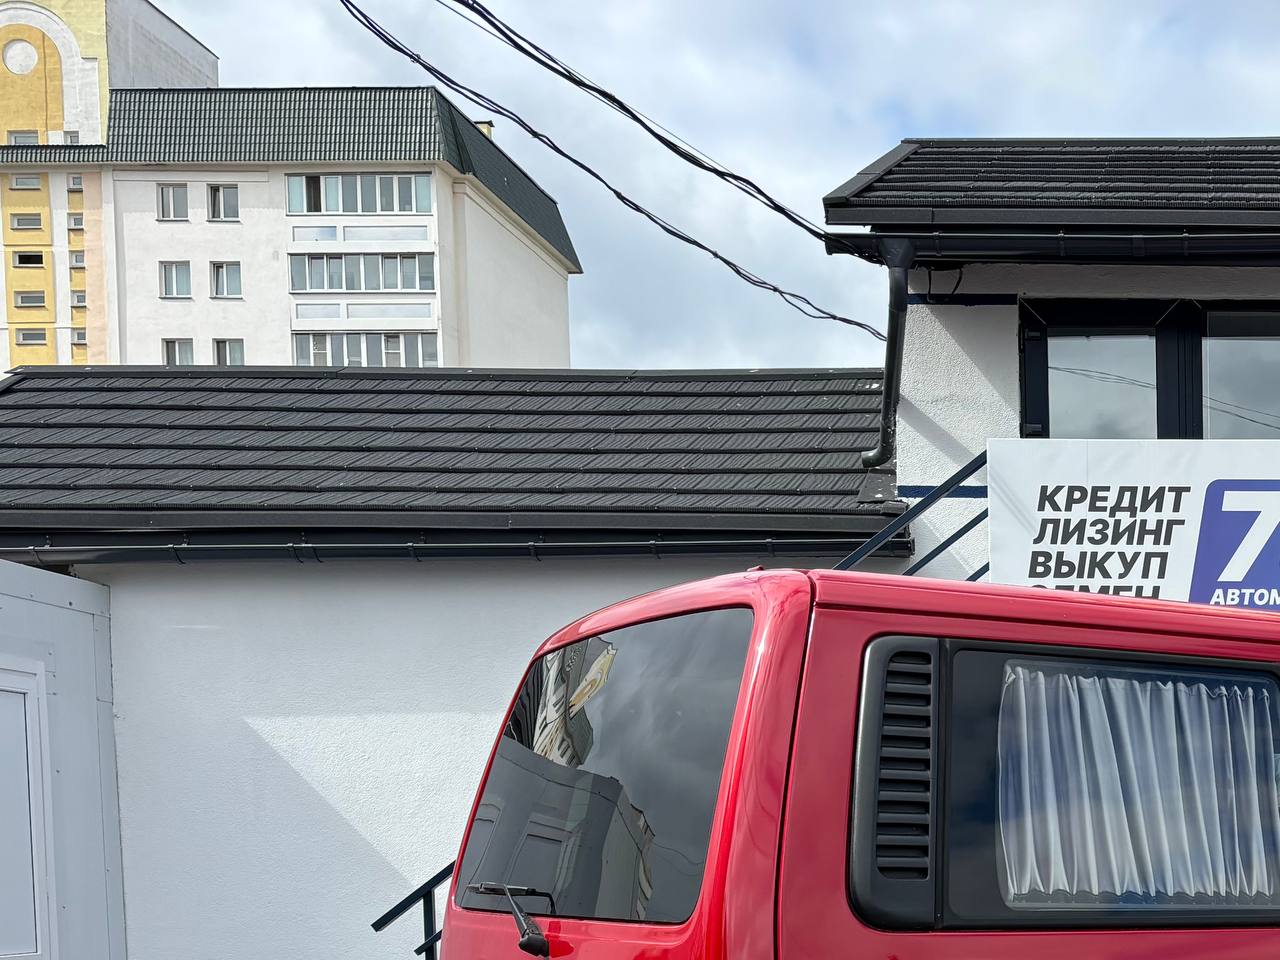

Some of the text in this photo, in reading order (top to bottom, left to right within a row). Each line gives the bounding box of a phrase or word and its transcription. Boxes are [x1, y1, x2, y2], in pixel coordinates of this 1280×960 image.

[1037, 485, 1191, 518] КРЕДИТ
[1033, 518, 1186, 546] ЛИЗИНГ
[1028, 550, 1169, 580] ВЫКУП
